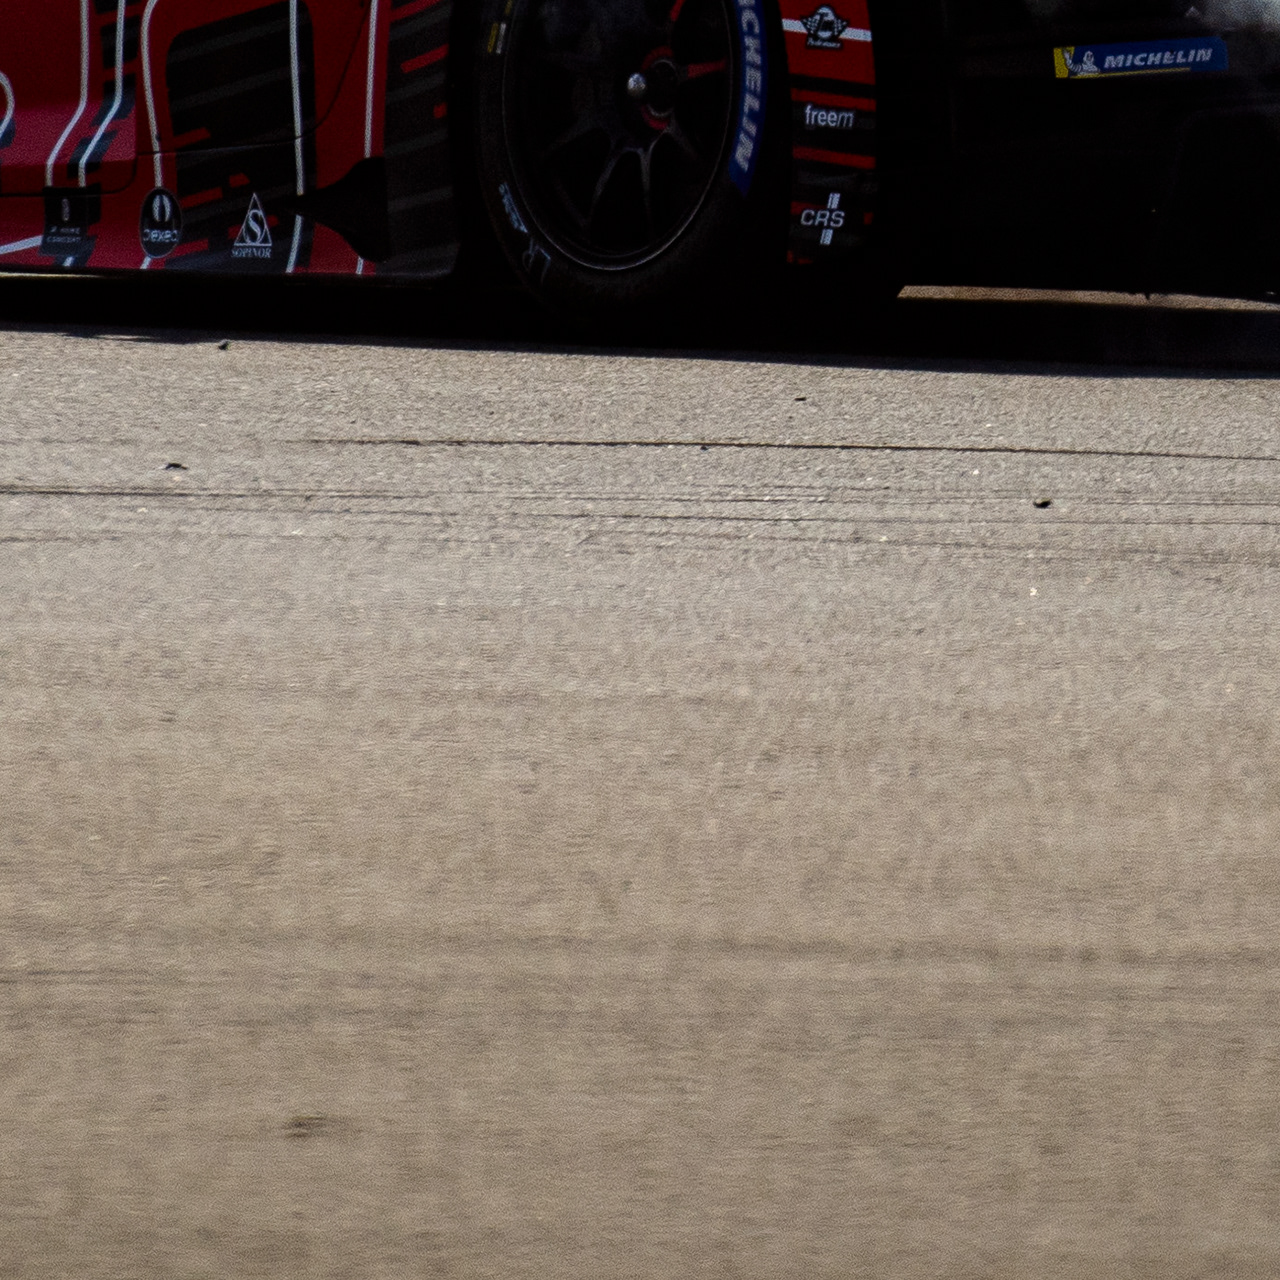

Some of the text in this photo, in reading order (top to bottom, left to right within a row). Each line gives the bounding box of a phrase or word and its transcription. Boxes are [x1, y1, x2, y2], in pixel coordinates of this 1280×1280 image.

[1103, 47, 1214, 69] MICHELIN
[805, 105, 855, 129] freem
[799, 207, 845, 228] CRS
[230, 247, 271, 259] SOPINOR
